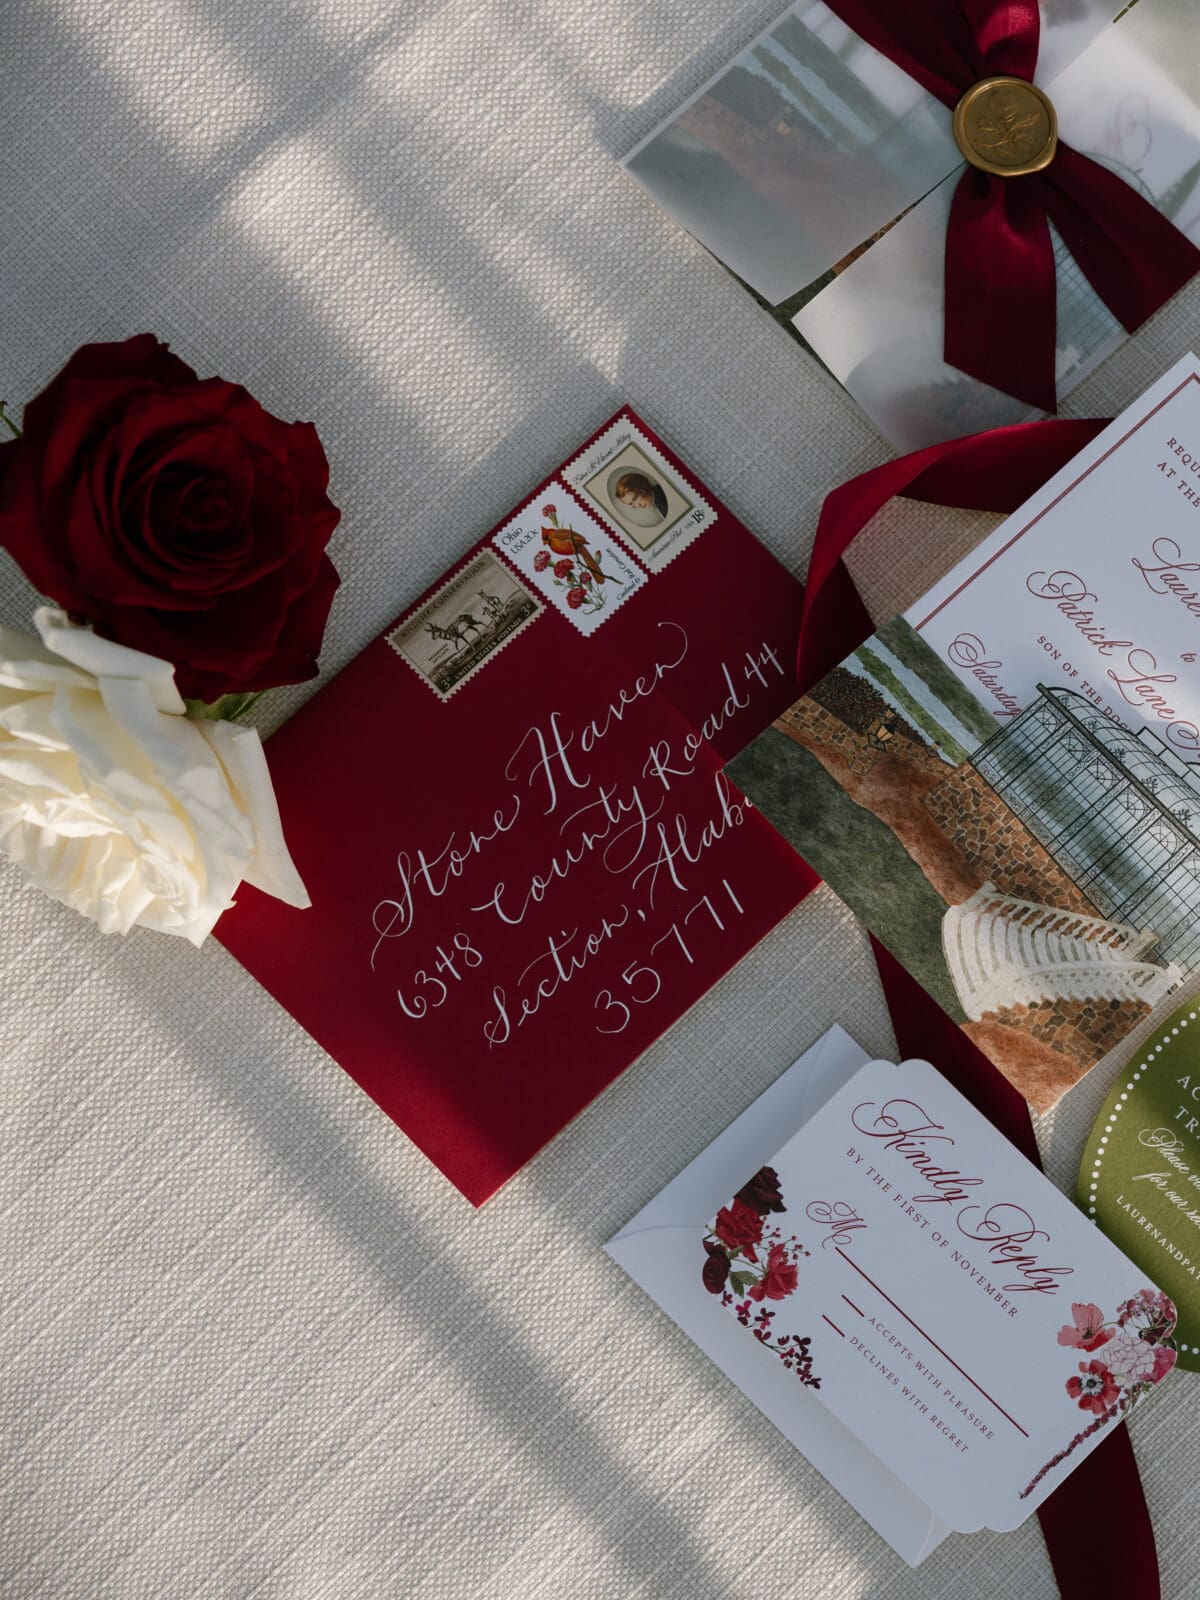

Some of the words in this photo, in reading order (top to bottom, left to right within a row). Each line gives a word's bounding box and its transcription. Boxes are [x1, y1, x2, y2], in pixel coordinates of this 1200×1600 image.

[1156, 462, 1176, 478] AT
[501, 526, 523, 547] Ohio
[433, 560, 486, 609] CONSERVATION
[454, 659, 476, 681] UNITED
[475, 640, 498, 661] STATES
[496, 617, 523, 644] POSTAGE
[947, 632, 1021, 718] Saturday
[1025, 570, 1133, 656] Patrick
[1106, 648, 1178, 720] Lane
[1036, 636, 1062, 660] SON
[1062, 662, 1078, 678] OF
[1080, 680, 1102, 704] THE
[1180, 651, 1198, 667] to
[371, 794, 520, 972] Stone
[505, 622, 688, 815] Haven
[398, 932, 483, 1019] 6348
[471, 782, 665, 925] County
[643, 661, 750, 790] Road
[743, 641, 785, 688] 44
[595, 878, 744, 1033] 35771
[1138, 1128, 1190, 1176] Please
[805, 1200, 867, 1249] M
[852, 1099, 984, 1206] Kindly
[956, 1203, 1074, 1294] Reply
[1132, 1172, 1172, 1190] for
[1164, 1190, 1188, 1214] our
[846, 1148, 864, 1164] BY
[866, 1166, 892, 1192] THE
[892, 1194, 930, 1228] FIRST
[932, 1232, 950, 1248] OF
[950, 1250, 1018, 1318] NOVEMBER
[850, 1336, 900, 1386] DECLINES
[902, 1386, 928, 1414] WITH
[930, 1414, 968, 1452] REGRET
[868, 1318, 914, 1360] ACCEPTS
[914, 1360, 942, 1388] WITH
[944, 1388, 994, 1440] PLEASURE
